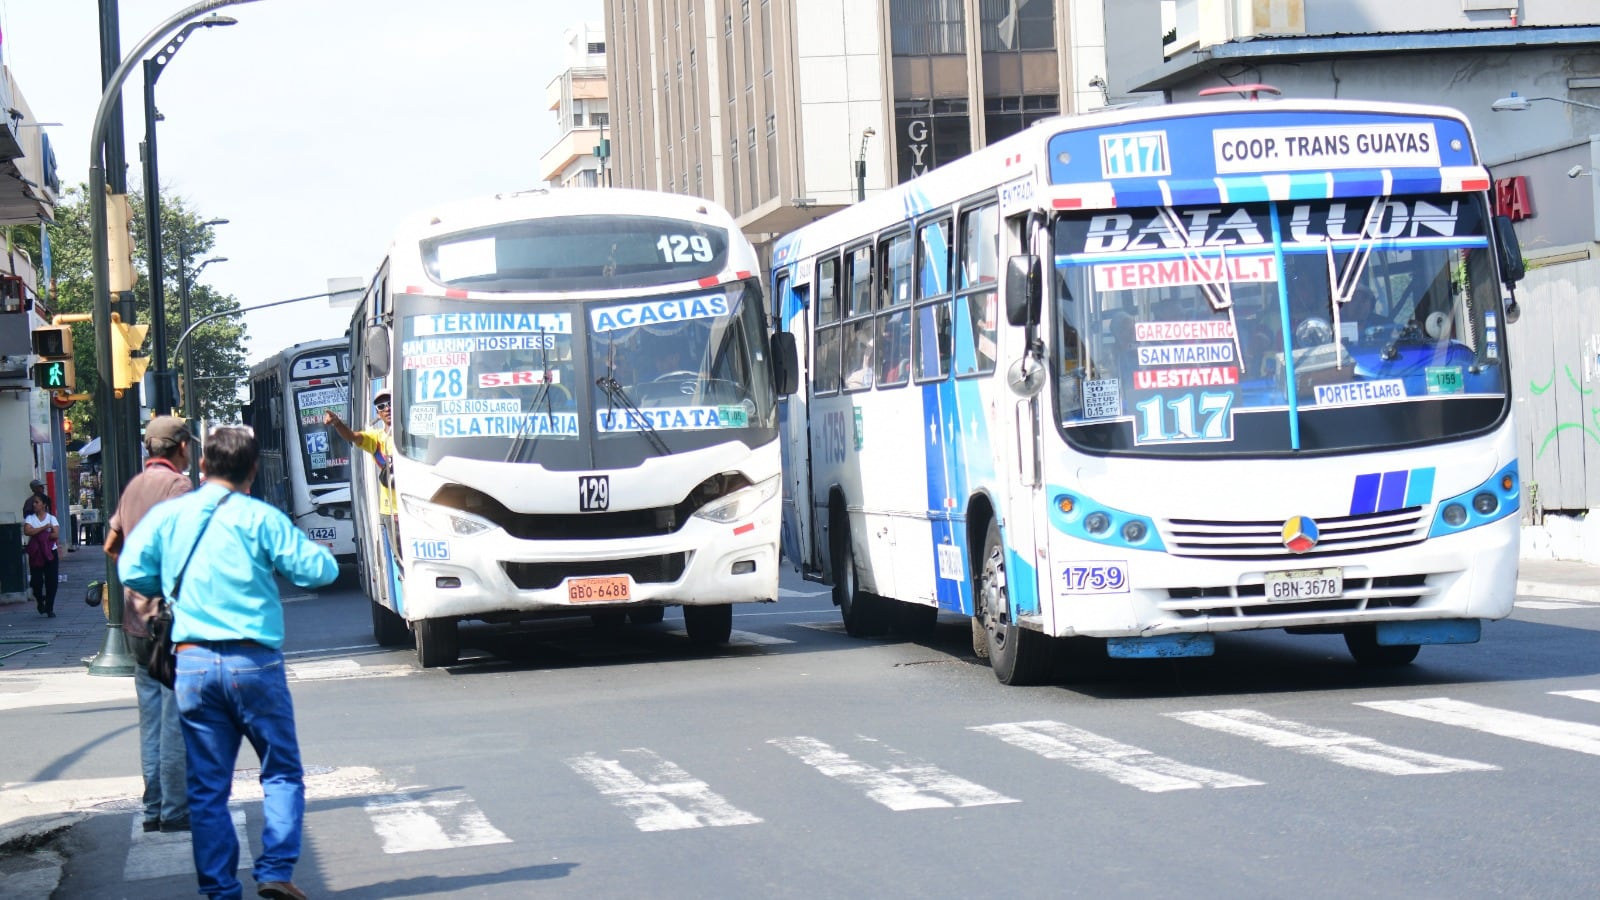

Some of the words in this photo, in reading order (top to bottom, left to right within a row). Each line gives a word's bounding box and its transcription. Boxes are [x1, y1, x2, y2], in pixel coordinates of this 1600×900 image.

[1108, 136, 1159, 173] 117
[1221, 140, 1278, 162] COOP.
[1285, 135, 1350, 156] TRANS
[1357, 132, 1430, 154] GUAYAS
[657, 235, 713, 263] 129
[597, 297, 726, 330] ACACIAS
[302, 359, 331, 370] 13
[403, 356, 426, 370] ALL
[1141, 348, 1170, 364] SAN
[1173, 345, 1231, 363] MARINO
[418, 368, 463, 401] 128
[1138, 367, 1235, 389] U.ESTATAL
[1436, 373, 1456, 386] 1759
[1318, 383, 1372, 404] PORTETE
[1372, 384, 1401, 399] LARG
[443, 402, 462, 413] LOS
[465, 401, 489, 413] RIOS
[490, 402, 519, 413] LARGO
[1136, 391, 1234, 442] 117
[438, 417, 481, 437] ISLA
[485, 415, 578, 435] TRINITARIA
[307, 436, 328, 452] 13
[823, 411, 846, 464] 1759
[581, 478, 608, 510] 129
[310, 529, 334, 539] 1424
[412, 541, 448, 559] 1105
[1062, 566, 1125, 590] 1759
[1273, 579, 1336, 598] GBN-3678
